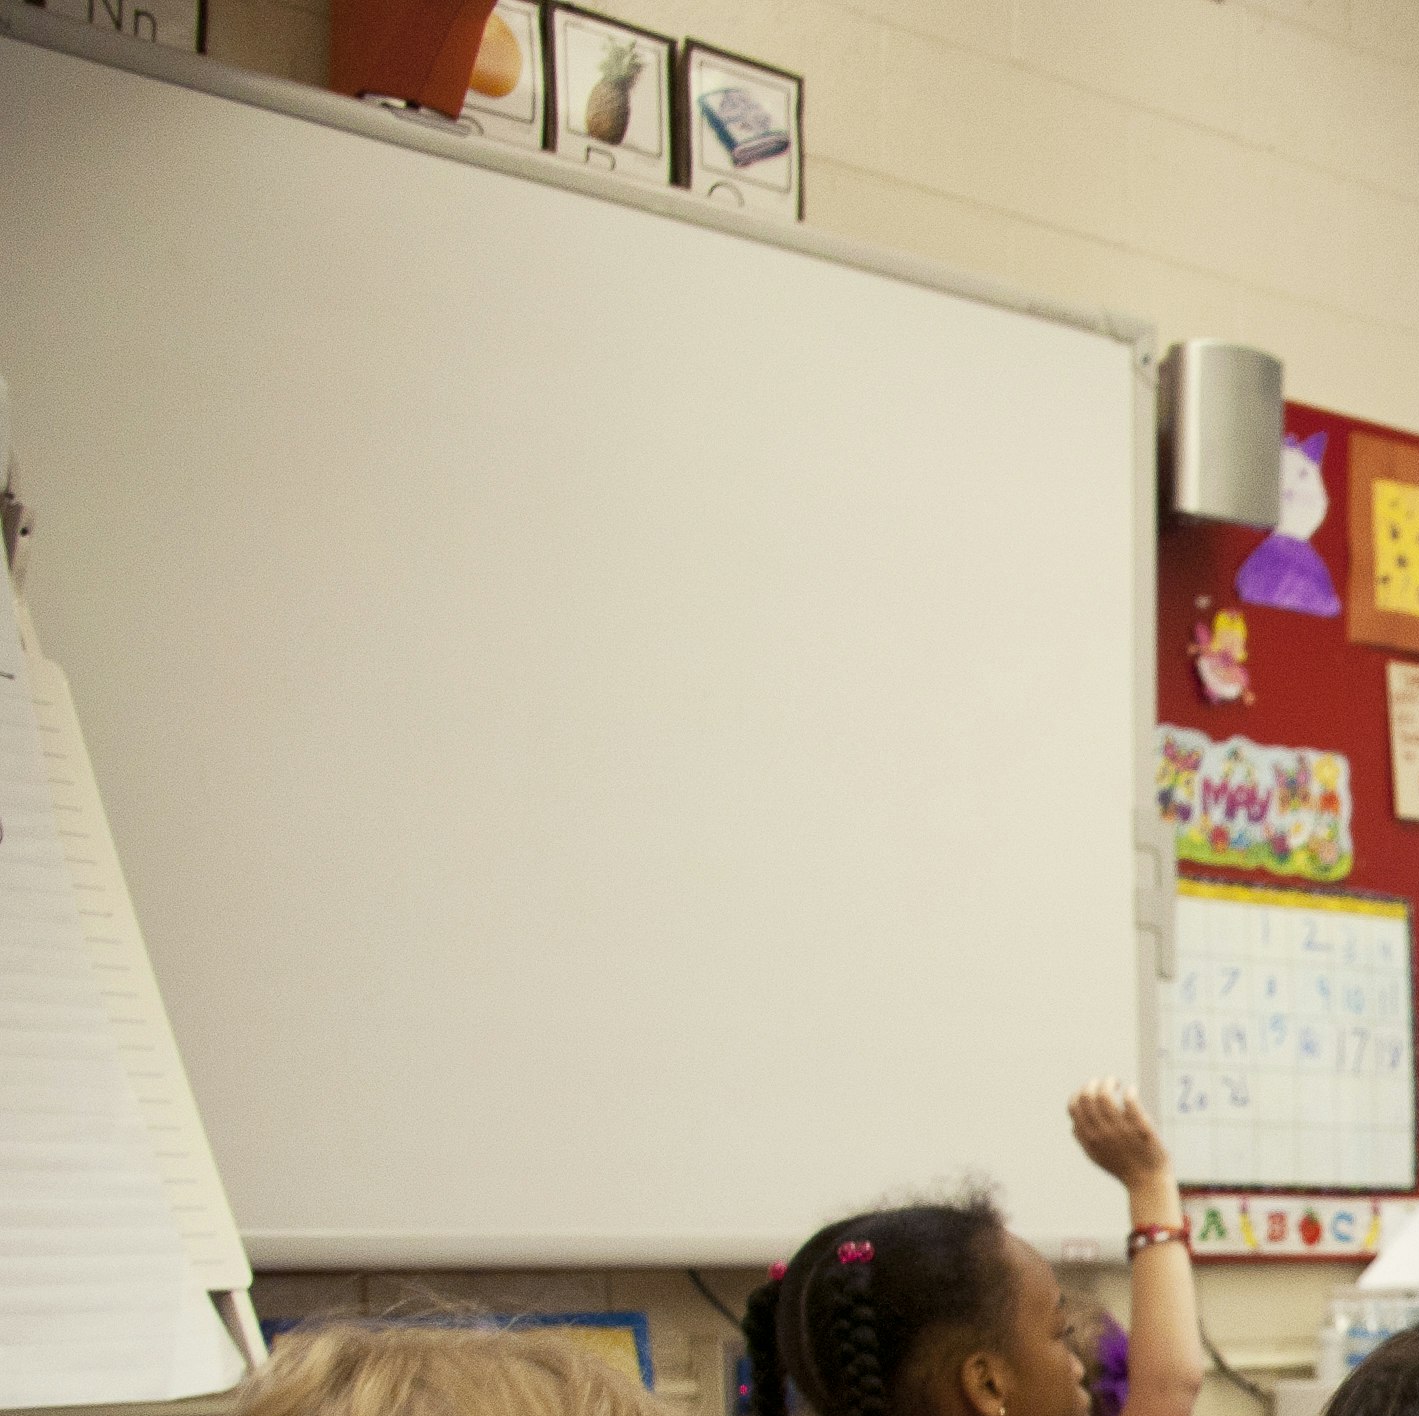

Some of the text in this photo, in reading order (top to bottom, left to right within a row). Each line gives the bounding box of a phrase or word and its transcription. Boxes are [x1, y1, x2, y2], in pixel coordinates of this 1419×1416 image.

[1333, 1024, 1372, 1078] 17
[1200, 1206, 1356, 1244] A B C
